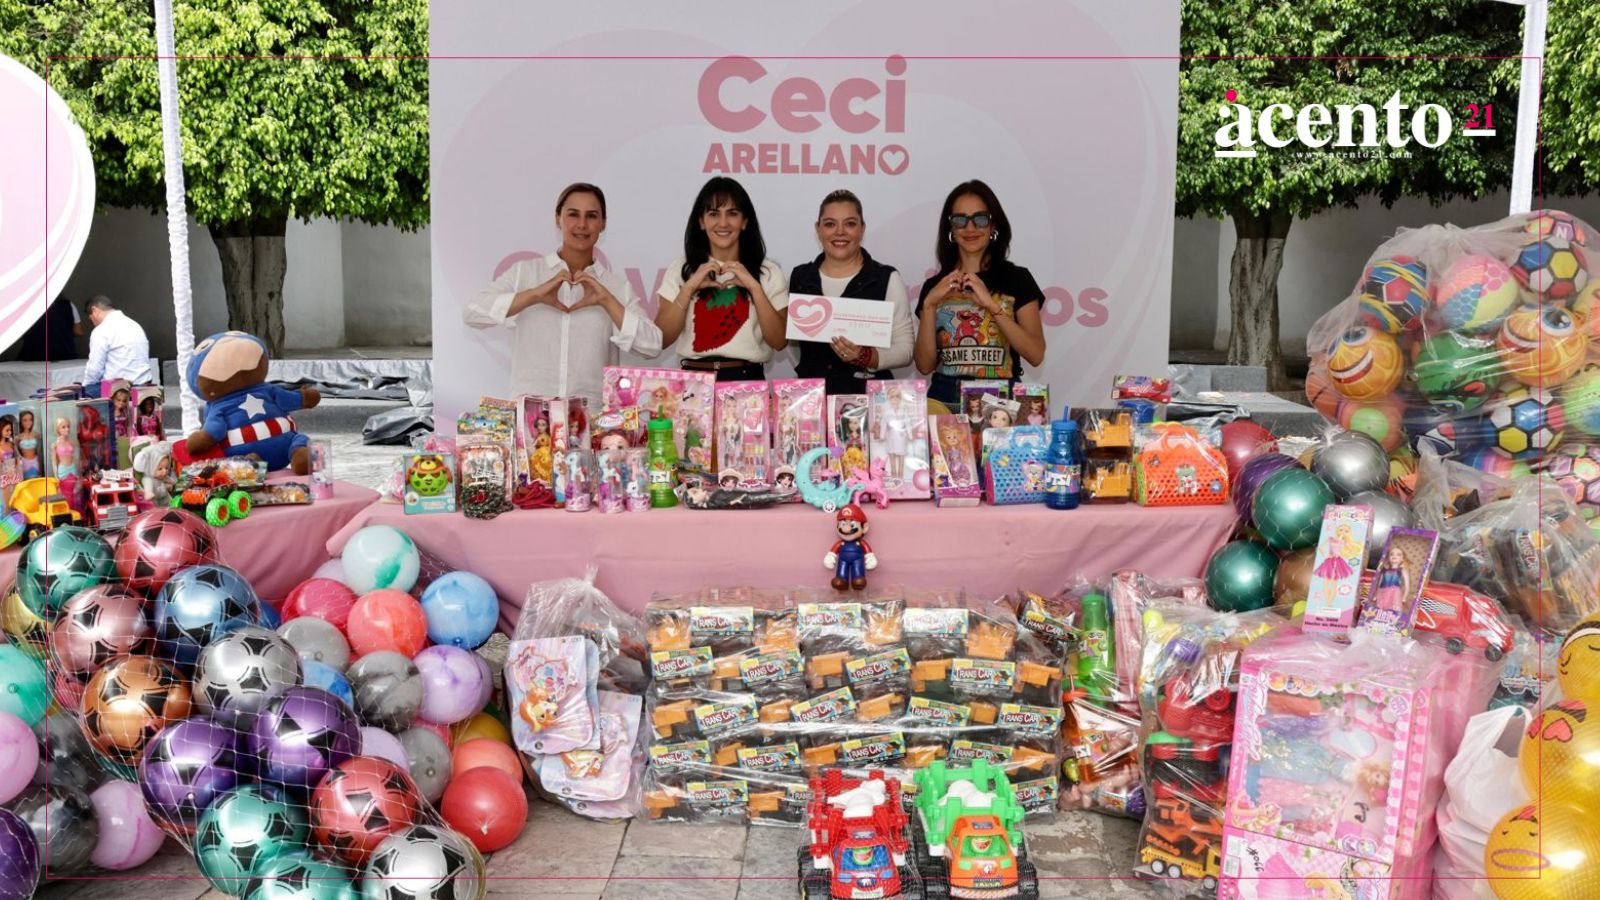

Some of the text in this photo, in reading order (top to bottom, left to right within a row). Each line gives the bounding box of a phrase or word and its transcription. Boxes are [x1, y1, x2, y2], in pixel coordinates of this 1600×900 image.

[697, 54, 907, 134] Ceci
[702, 142, 910, 176] ARELLANO
[971, 348, 1002, 362] STREET
